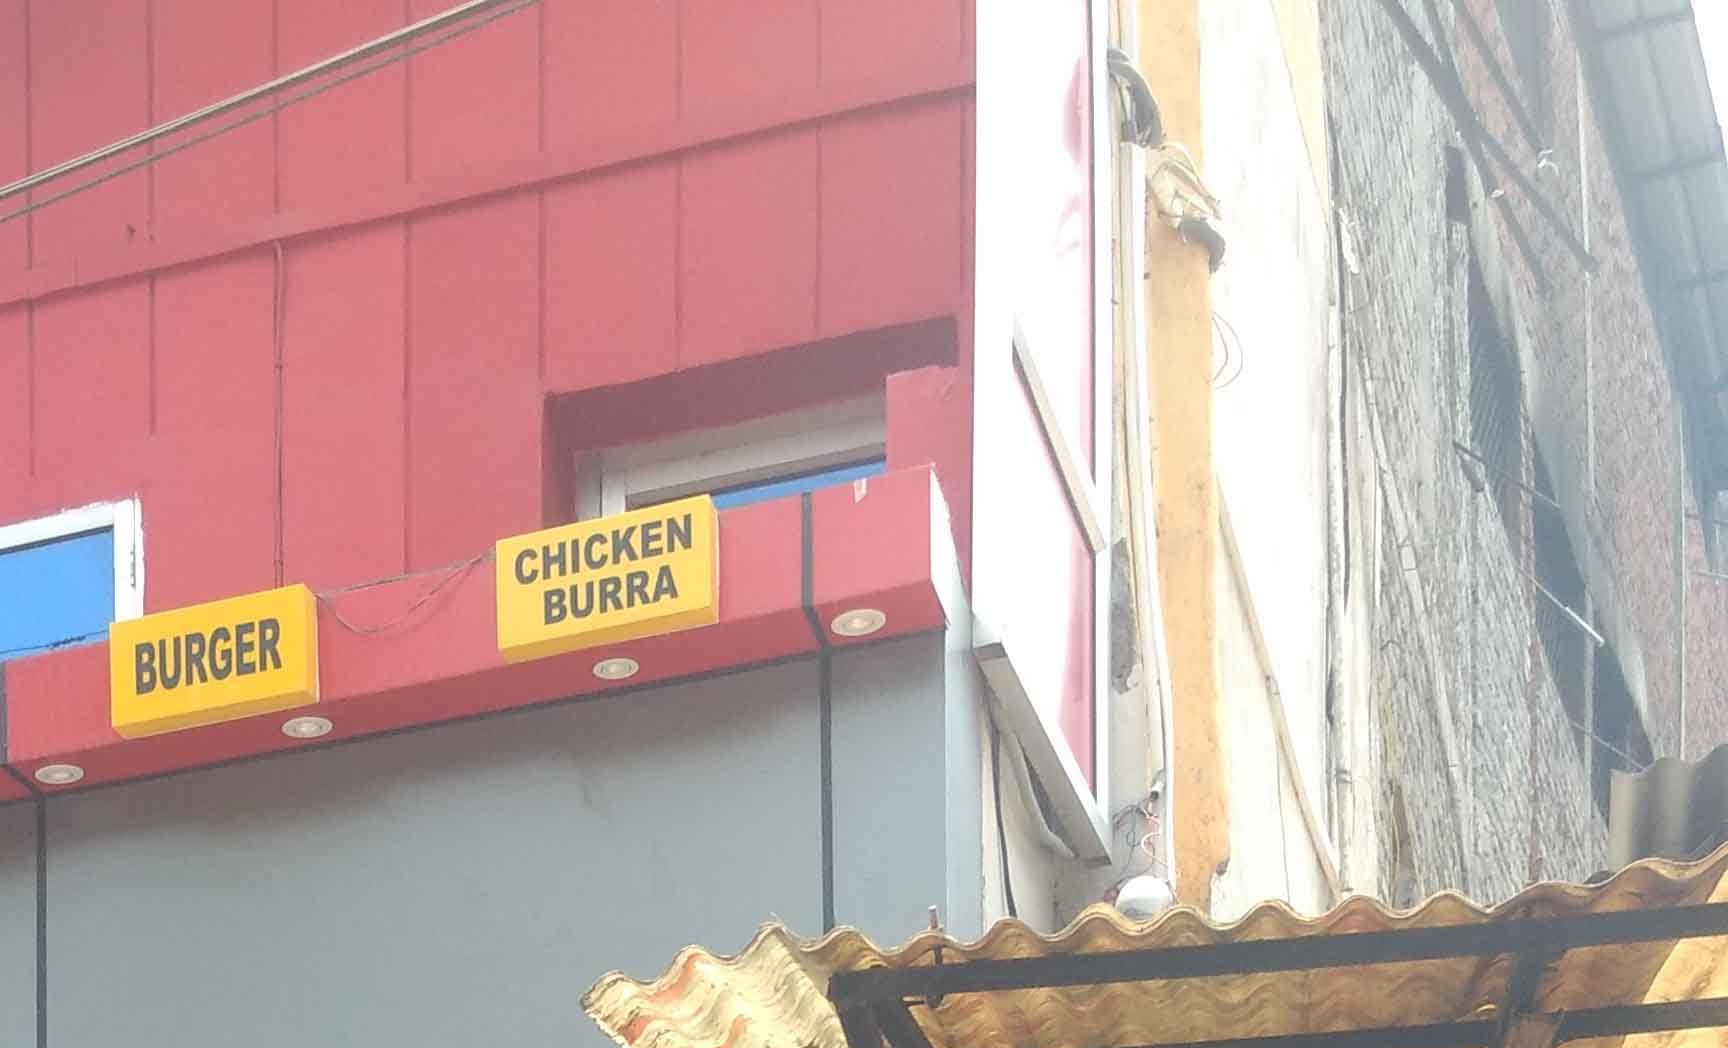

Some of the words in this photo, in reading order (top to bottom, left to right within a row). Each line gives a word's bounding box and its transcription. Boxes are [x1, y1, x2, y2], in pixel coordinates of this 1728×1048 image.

[513, 512, 694, 587] CHICKEN
[542, 564, 679, 626] BURRA
[134, 617, 282, 697] BURGER
